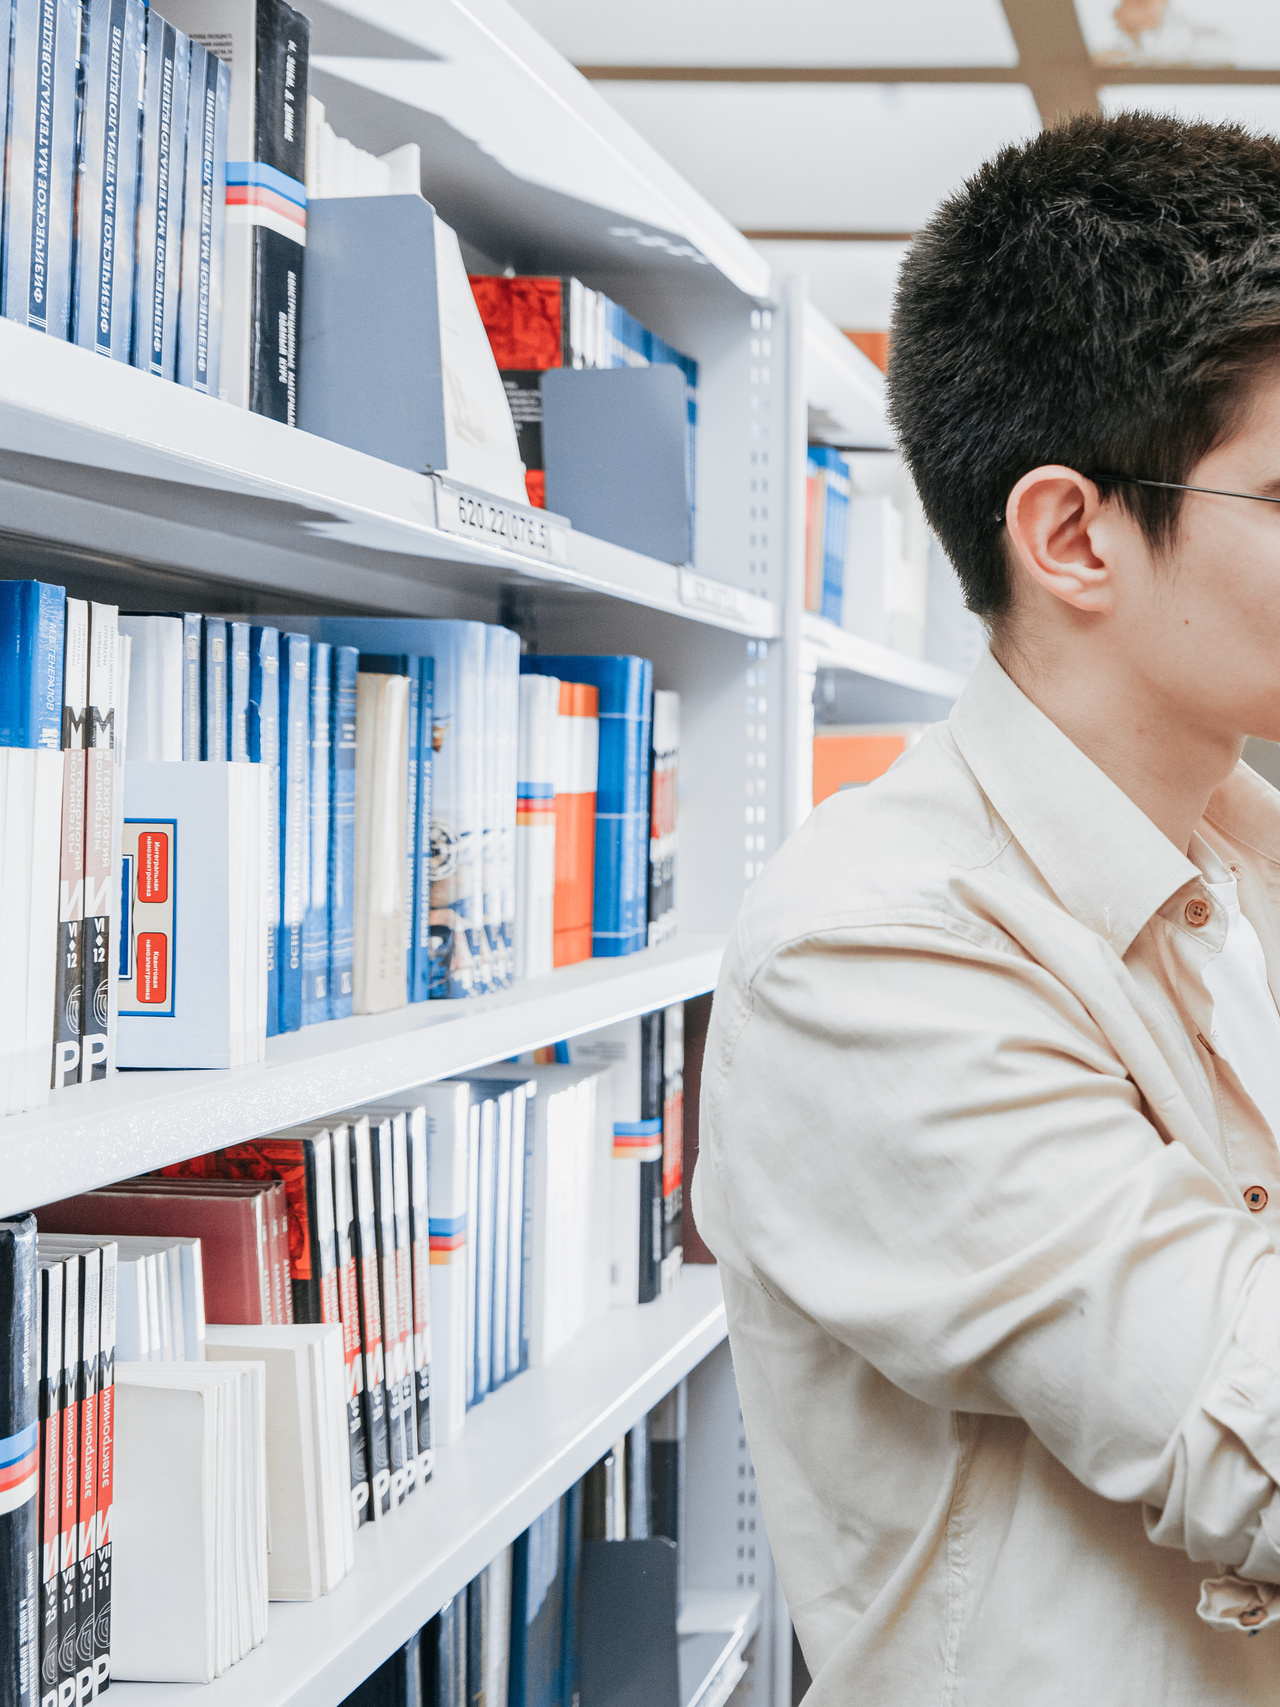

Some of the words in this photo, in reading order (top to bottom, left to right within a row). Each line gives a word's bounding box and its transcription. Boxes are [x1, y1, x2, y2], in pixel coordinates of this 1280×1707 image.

[104, 26, 122, 213] МАТЕРИАЛОВЕДЕНИЕ
[157, 57, 173, 236] МАТЕРИАЛОВЕДЕНИЕ
[201, 88, 216, 260] МАТЕРИАЛОВЕДЕНИЕ
[34, 180, 48, 303] ФИЗИЧЕСКОЕ
[99, 215, 114, 333] ФИЗИЧЕСКОЕ
[153, 238, 166, 352] ФИЗИЧЕСКОЕ
[197, 262, 210, 372] ФИЗИЧЕСКОЕ
[46, 648, 57, 711] ГЕНЕРАЛОВ
[68, 751, 77, 853] материалов
[75, 770, 83, 871] технологий
[94, 749, 103, 850] материалов
[102, 769, 110, 868] технологий
[153, 841, 161, 892] Интегральная
[67, 953, 77, 968] 12
[93, 947, 105, 963] 12
[144, 939, 152, 1000] наноэлектроника
[152, 951, 160, 989] Квантовая
[49, 1416, 57, 1519] электроники
[66, 1406, 74, 1509] электроники
[84, 1398, 93, 1500] электроники
[102, 1389, 111, 1488] электроники
[46, 1605, 57, 1626] 25
[63, 1594, 73, 1613] 11
[81, 1584, 92, 1603] 11
[98, 1572, 110, 1590] 11
[20, 1645, 29, 1695] ПРИБОРЫ
